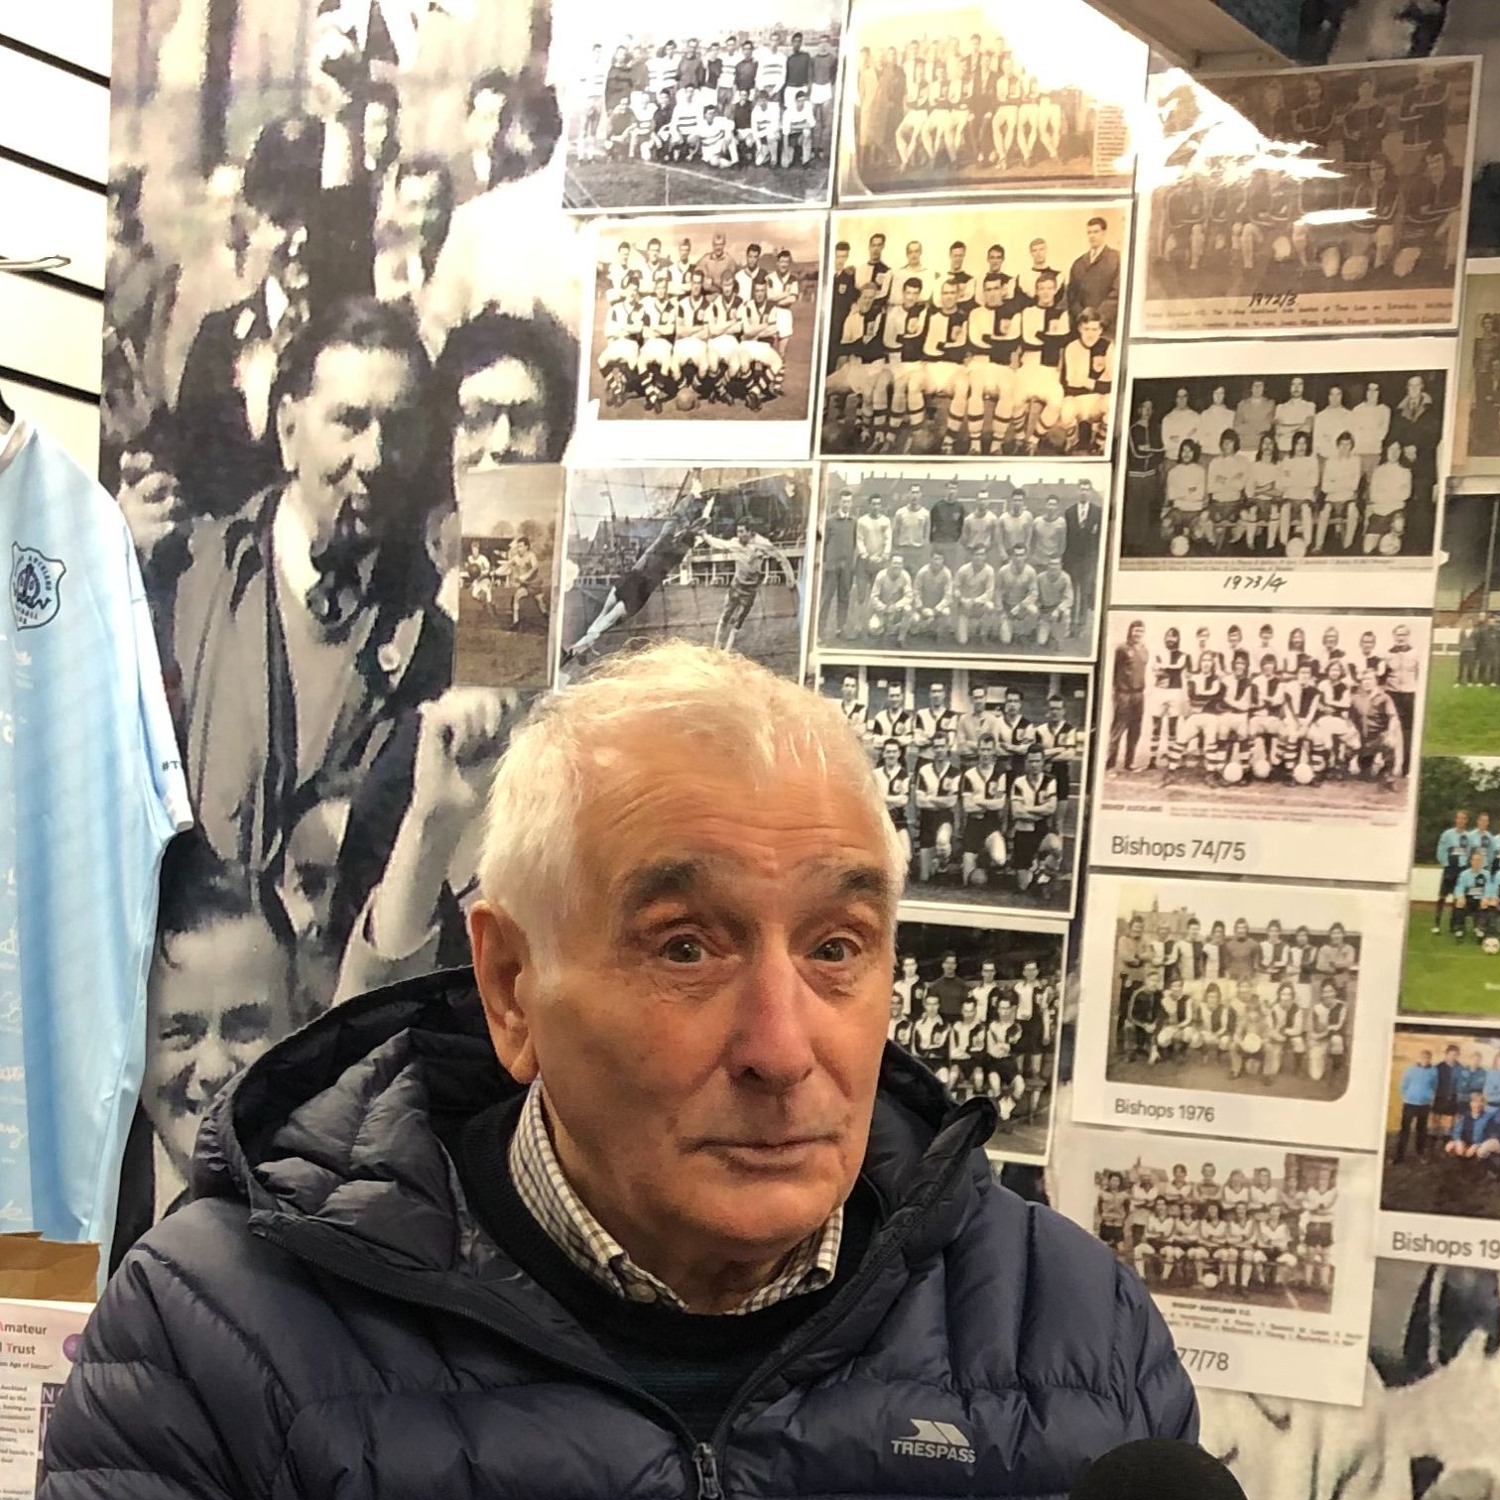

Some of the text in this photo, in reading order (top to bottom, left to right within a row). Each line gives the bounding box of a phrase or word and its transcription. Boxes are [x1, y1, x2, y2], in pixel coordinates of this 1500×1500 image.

[1249, 290, 1298, 307] 1972/3
[1223, 572, 1287, 591] 1973/4
[1111, 835, 1247, 863] Bishops 74/75
[1115, 1098, 1215, 1122] Bishops 1976
[1392, 1231, 1473, 1258] Bishops
[6, 1342, 36, 1355] Trust
[891, 1440, 976, 1464] TRESPASS
